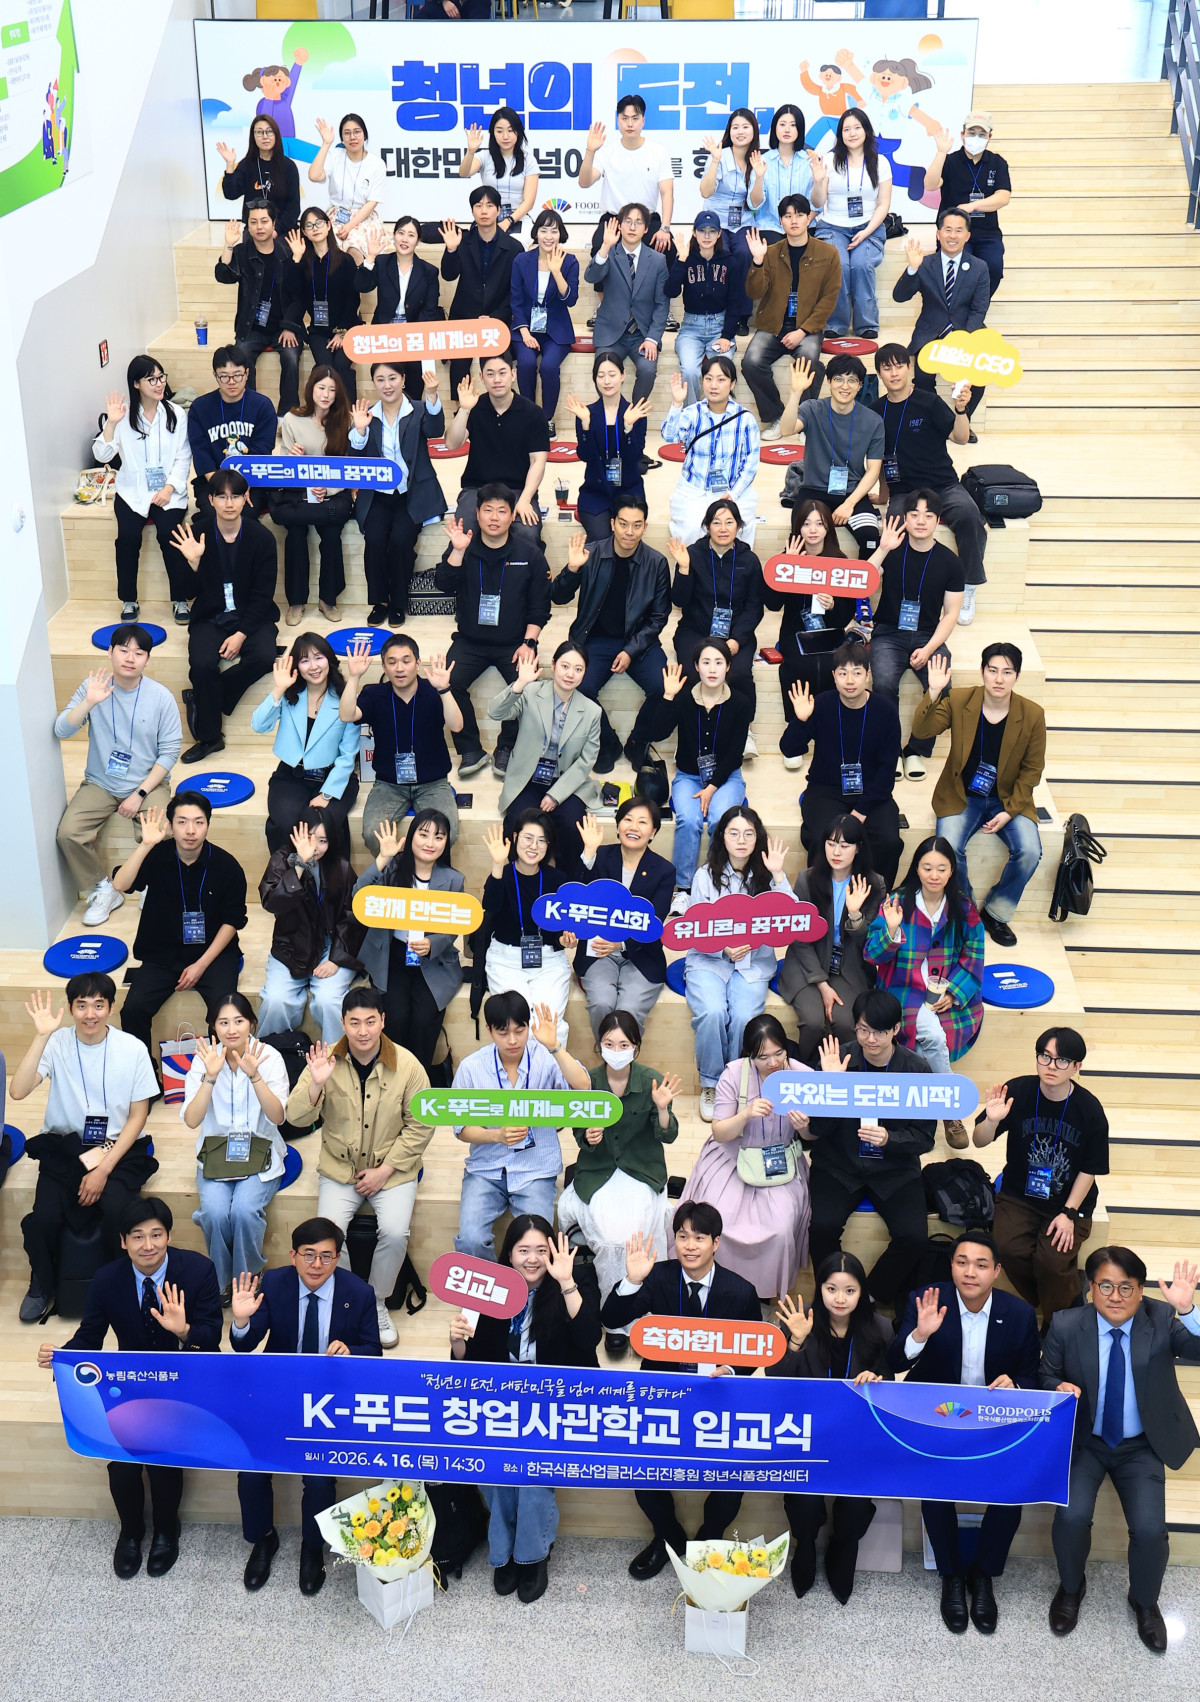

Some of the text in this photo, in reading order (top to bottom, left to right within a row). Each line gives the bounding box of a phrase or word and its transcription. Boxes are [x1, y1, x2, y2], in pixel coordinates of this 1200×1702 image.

[391, 60, 592, 131] 청년의
[380, 147, 472, 179] 대한민
[352, 328, 500, 355] 청년의 꿈 세계의 맛
[928, 343, 1015, 376] 내일의 CEO
[229, 463, 393, 482] K-푸드의 미래를 꿈꾸며
[774, 563, 869, 590] 오늘의 입교
[364, 895, 471, 925] 함께 만드는
[545, 900, 651, 932] K-푸드 신화
[674, 914, 811, 939] 유니콘을 꿈꾸며
[420, 1098, 612, 1119] K-푸드로 세계를 잇다
[779, 1082, 960, 1109] 맛있는 도전 시작!
[445, 1265, 509, 1306] 입교를
[642, 1326, 774, 1357] 축하합니다!
[105, 1370, 179, 1382] 농림축산식품부
[470, 1377, 498, 1393] 도전,
[501, 1377, 566, 1398] 대한민국을
[569, 1381, 595, 1398] 넘어
[598, 1380, 636, 1402] 세계를
[303, 1393, 813, 1452] K-푸드 창업사관학교 입교식
[977, 1404, 1052, 1417] FOODPOLIS
[304, 1450, 486, 1473] 일시 2026. 4. 16. (목) 14:30
[503, 1460, 809, 1483] 장소 한국식품산업클러스터진흥원 청년식품창업센터
